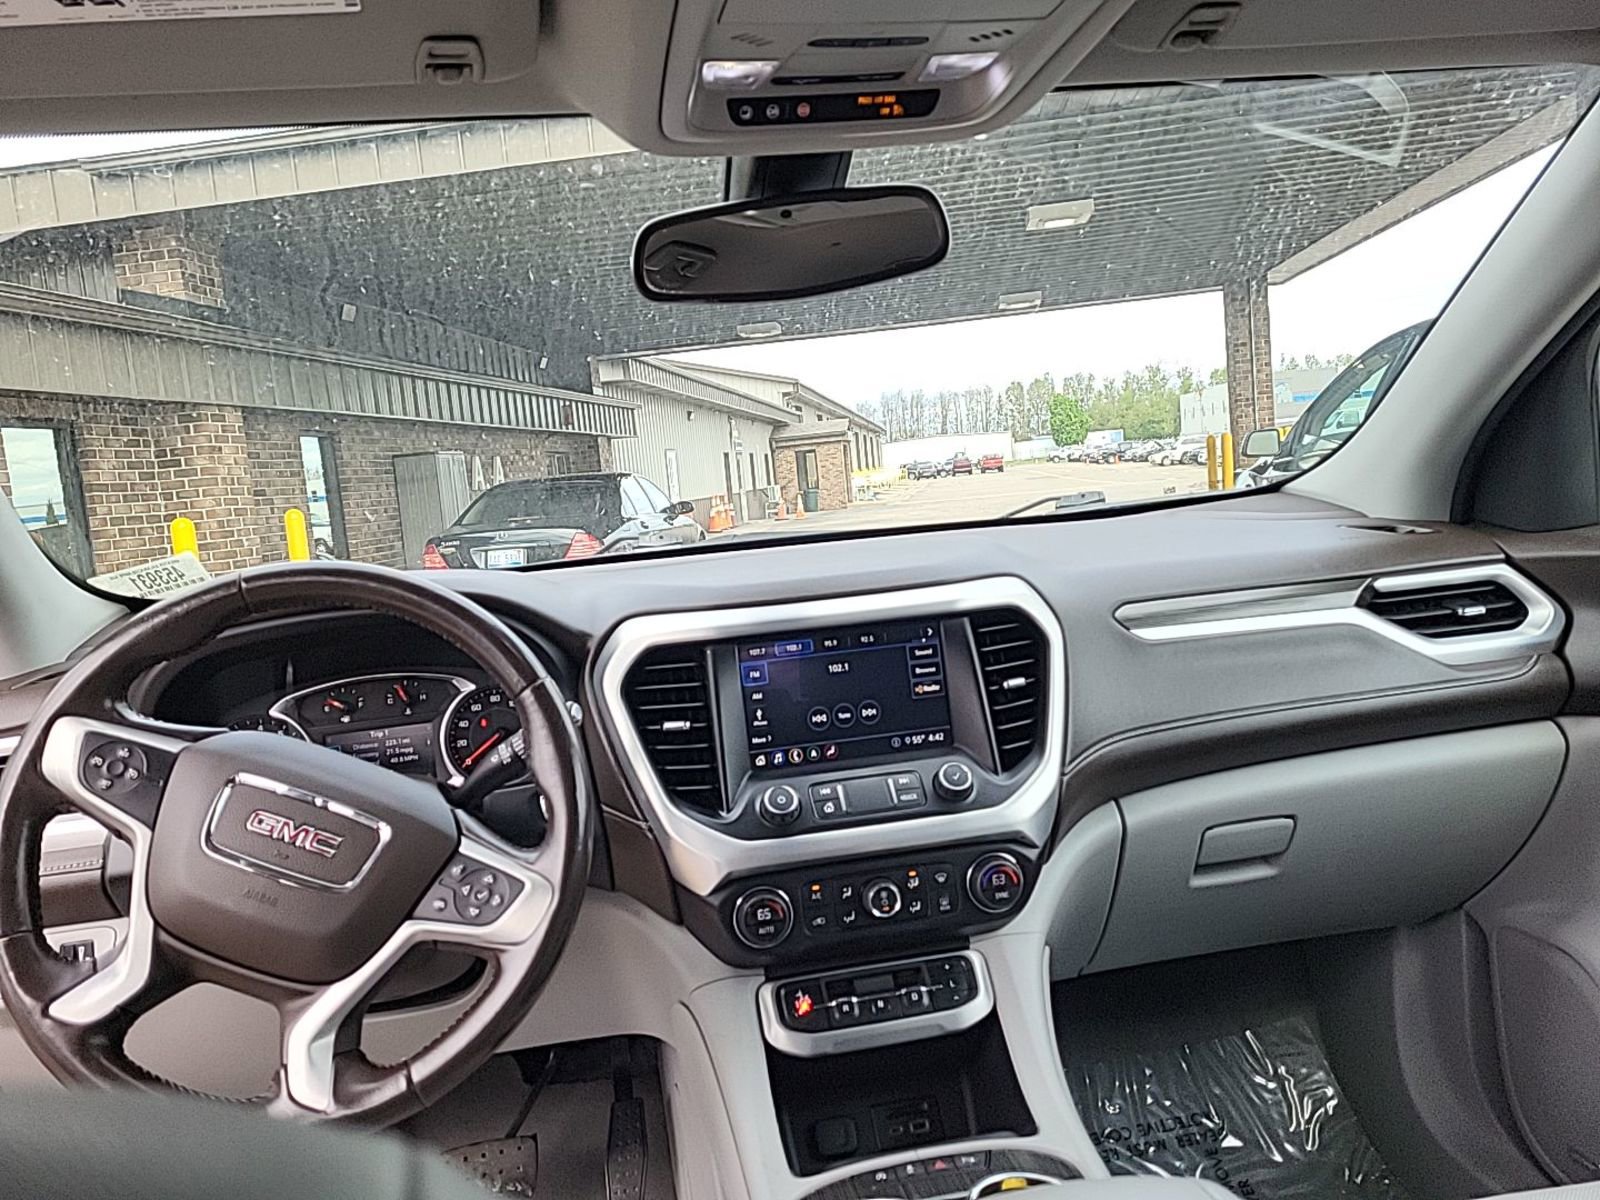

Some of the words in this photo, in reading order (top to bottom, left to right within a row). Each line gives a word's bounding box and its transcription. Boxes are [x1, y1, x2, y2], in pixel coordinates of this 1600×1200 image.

[827, 662, 850, 674] 102.1
[489, 694, 501, 703] 80
[470, 703, 482, 712] 60
[458, 720, 469, 728] 40
[369, 731, 384, 740] Trip
[456, 739, 468, 748] 20
[245, 808, 345, 859] GMC
[991, 873, 1006, 886] 63
[756, 907, 772, 921] 65
